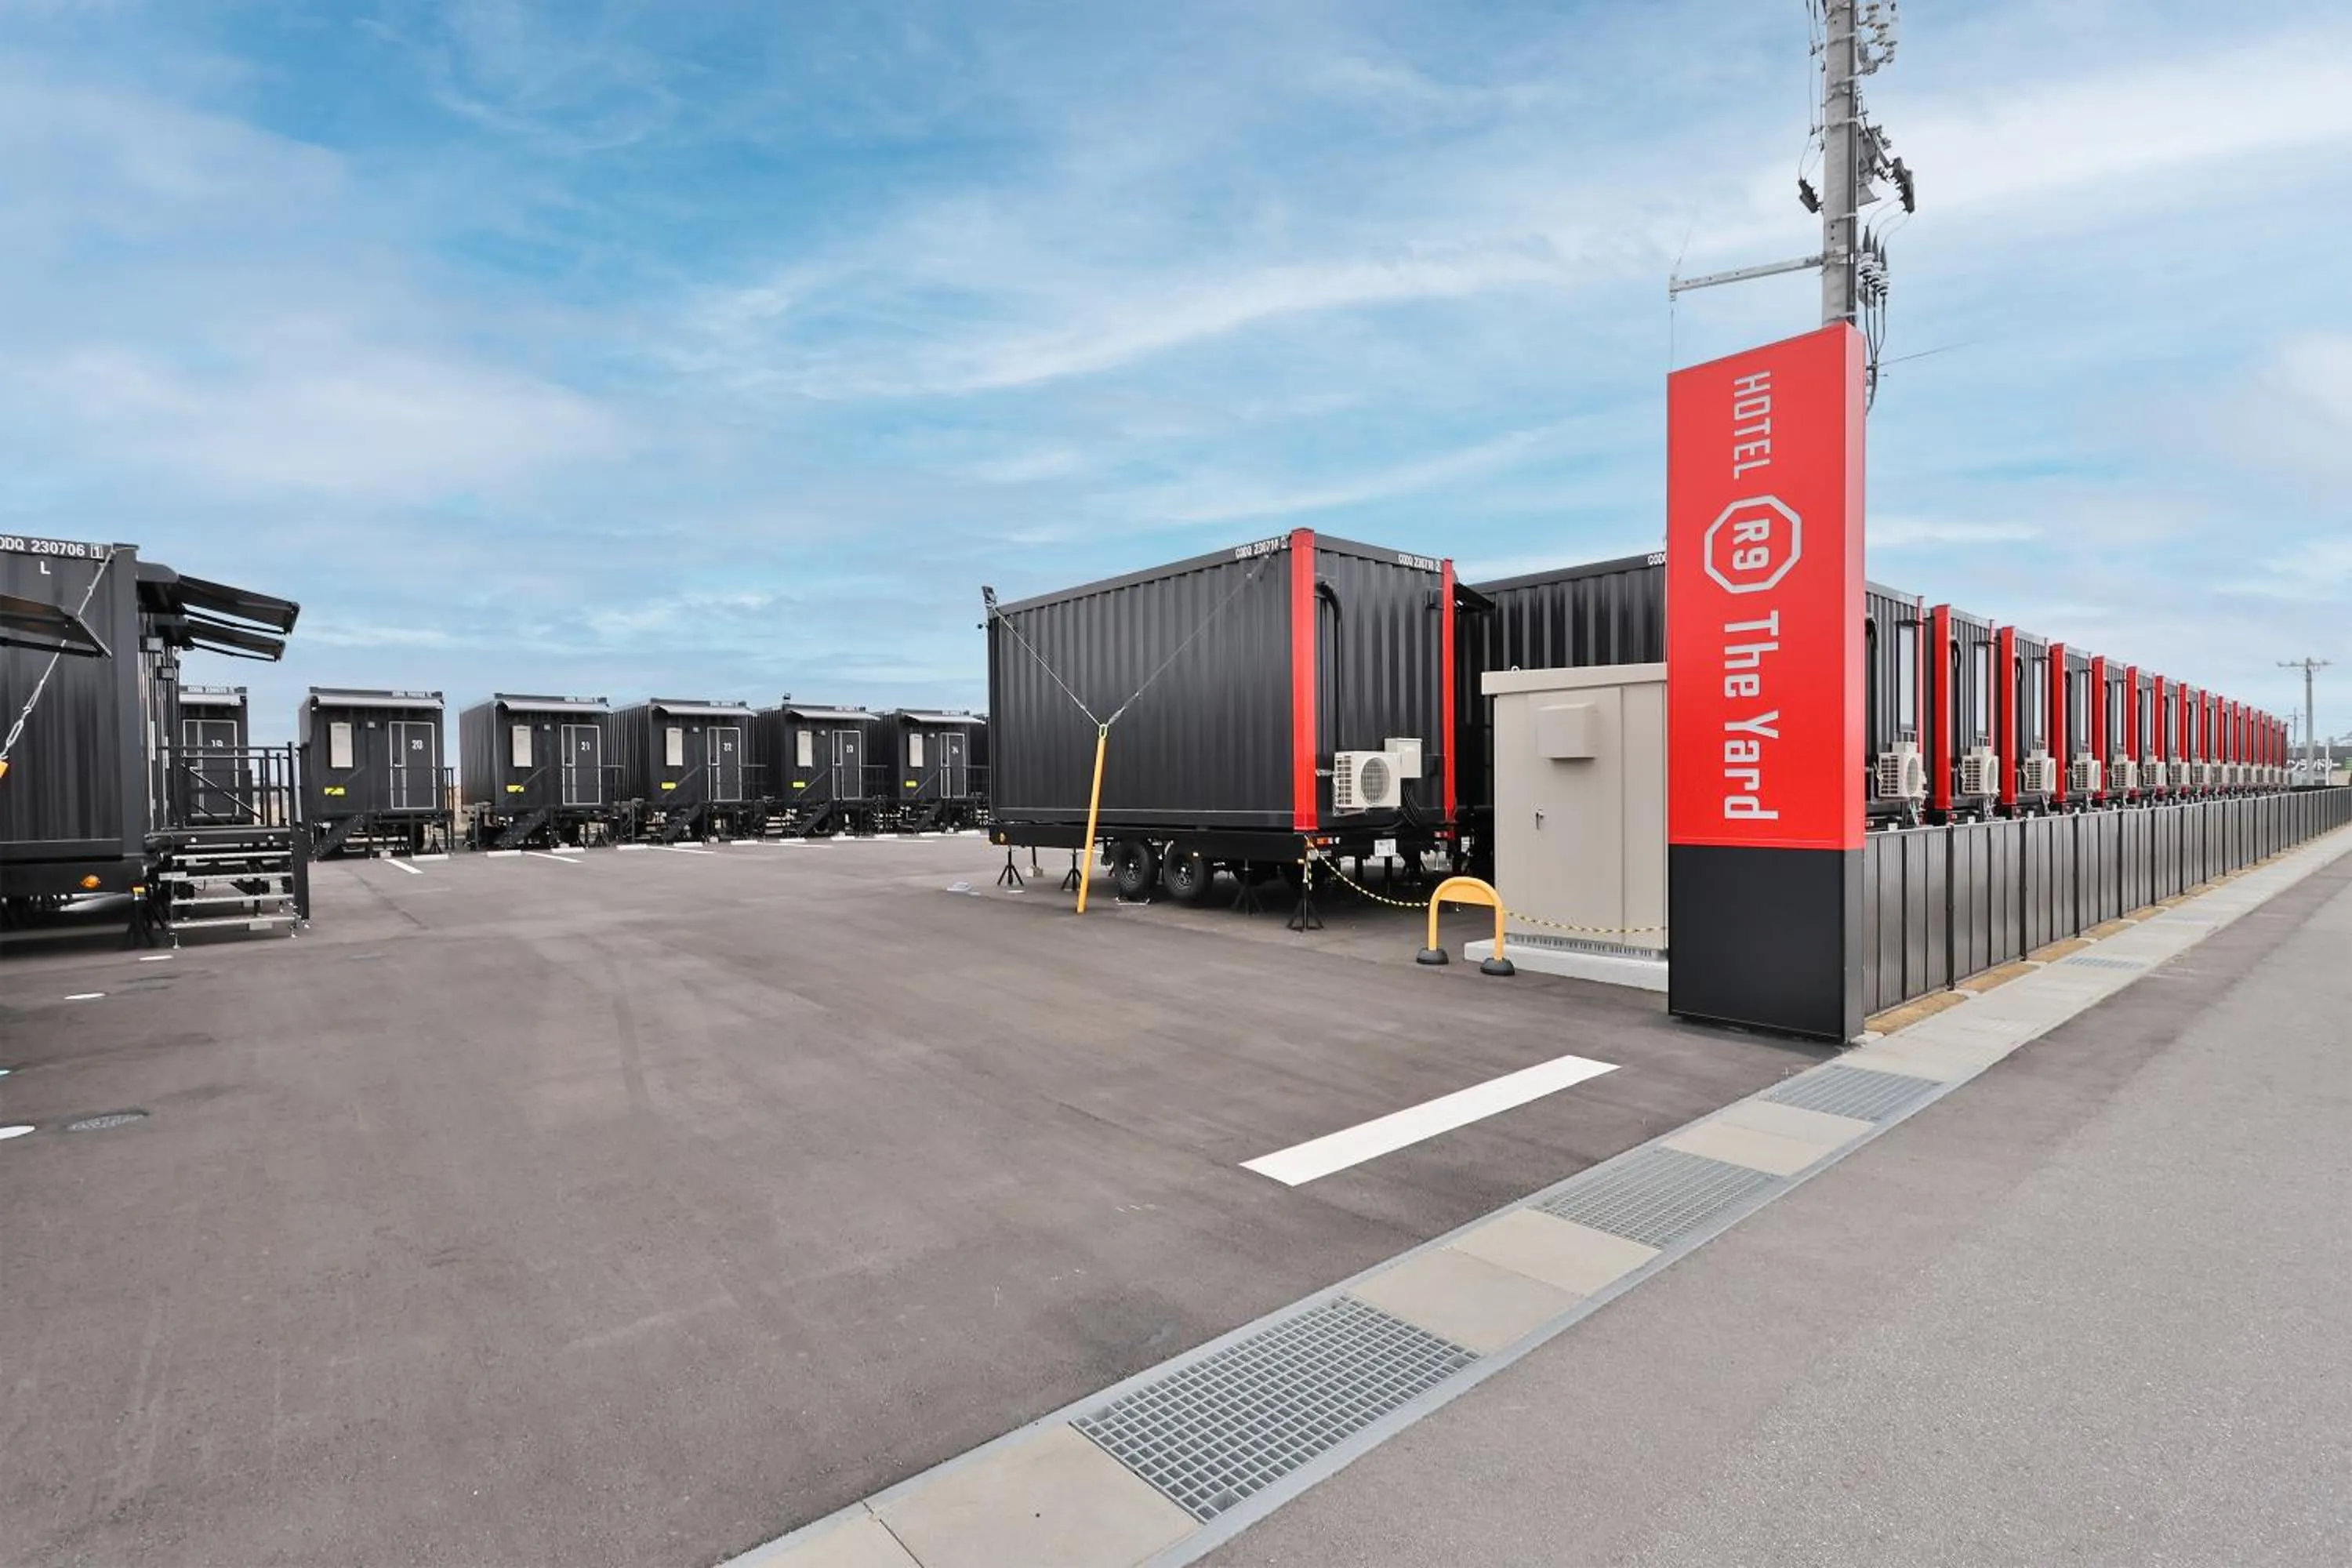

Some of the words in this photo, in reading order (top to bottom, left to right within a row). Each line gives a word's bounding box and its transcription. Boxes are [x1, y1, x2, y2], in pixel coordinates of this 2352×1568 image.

[1733, 370, 1771, 480] HOTEL
[31, 539, 85, 556] 230706
[40, 561, 51, 574] L
[1733, 517, 1769, 571] R9
[1724, 609, 1779, 698] The
[1724, 710, 1779, 820] Yard
